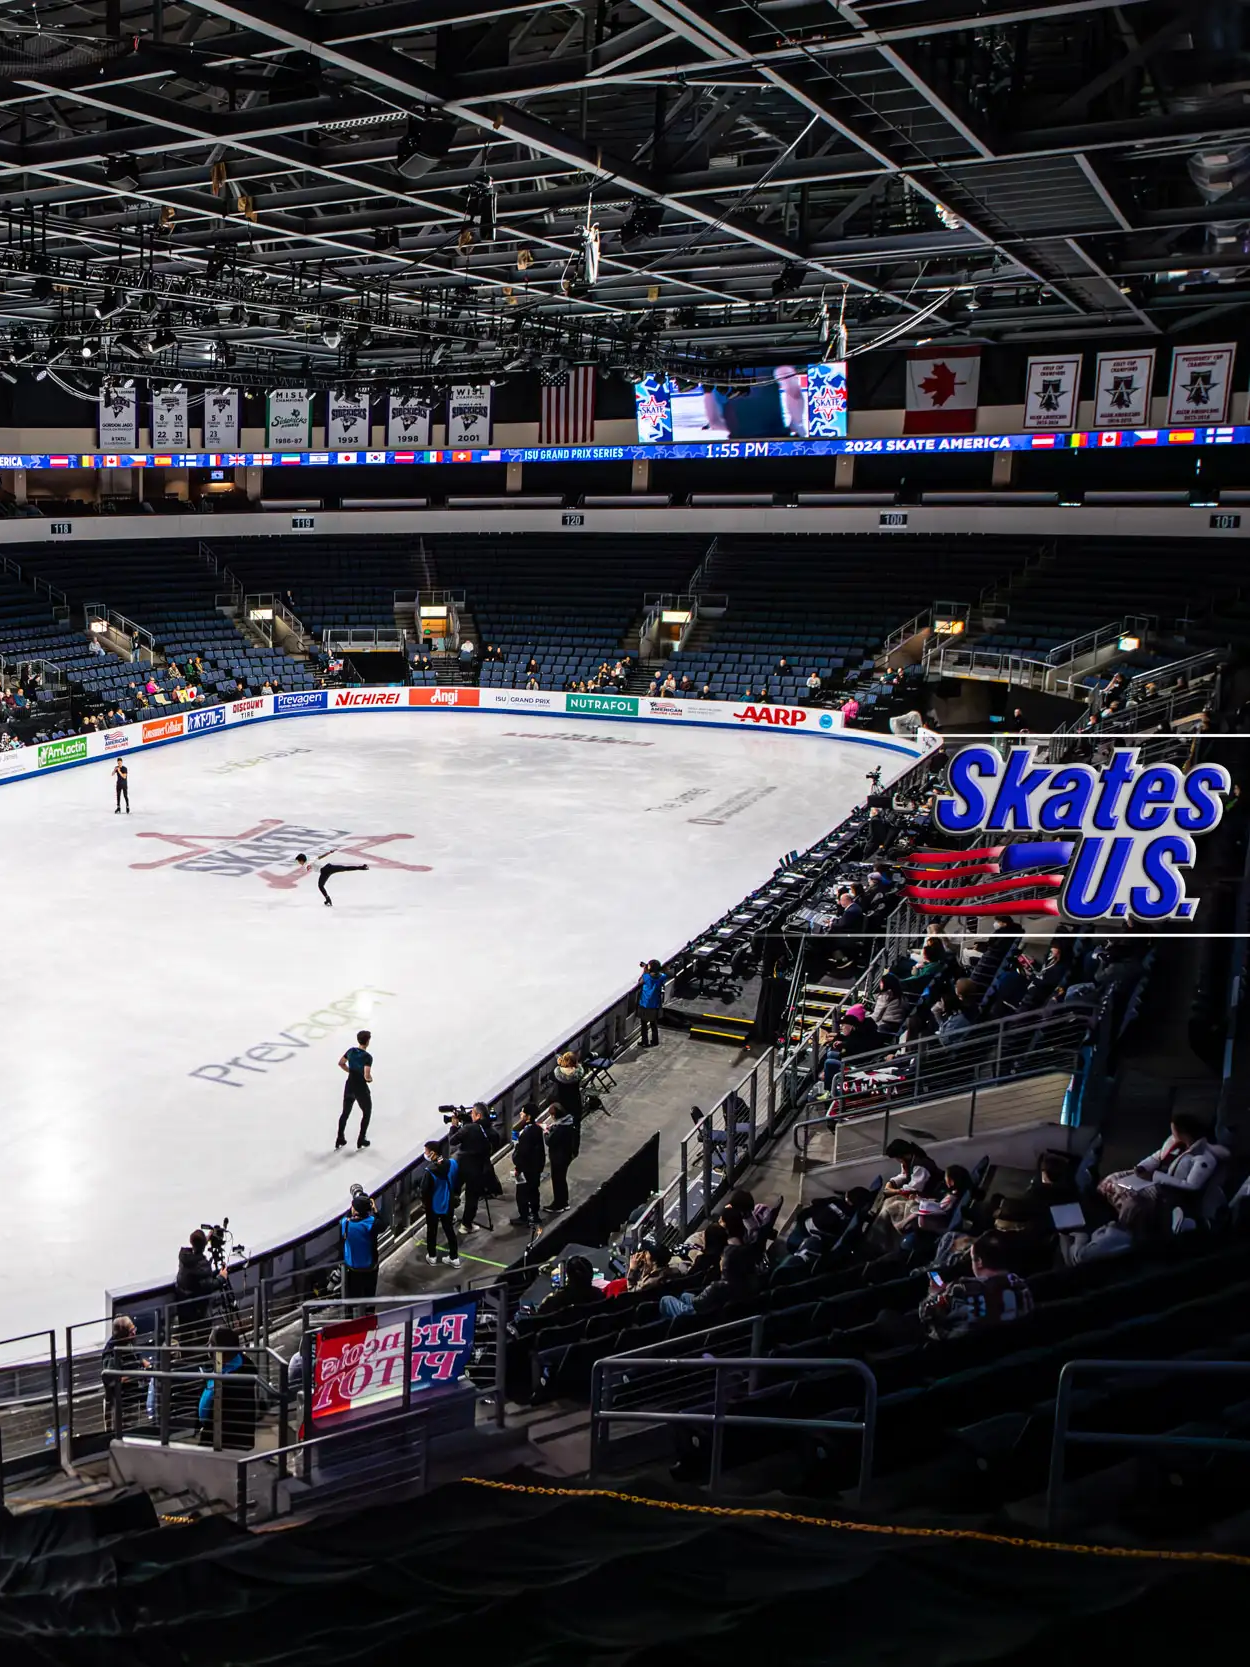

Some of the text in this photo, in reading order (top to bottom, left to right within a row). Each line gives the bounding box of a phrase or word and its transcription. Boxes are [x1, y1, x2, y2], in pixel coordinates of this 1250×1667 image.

[210, 430, 218, 438] 23
[338, 436, 359, 444] 1993
[707, 442, 769, 458] 1:55 PM
[845, 437, 1011, 452] 2024 SKATE AMERICA
[525, 448, 624, 460] ISU GRAND PRIX SERIES
[296, 519, 310, 528] 119
[566, 516, 580, 525] 120
[884, 514, 903, 526] 100
[1214, 515, 1235, 528] 101
[54, 524, 69, 534] 118
[278, 692, 322, 705] Prevagen
[335, 691, 400, 706] NICHIREI
[431, 689, 458, 705] Angi
[232, 699, 264, 713] DISCOUNT
[570, 698, 634, 712] NUTRAFOL
[241, 711, 254, 719] TIRE
[734, 706, 806, 727] AARP
[105, 736, 128, 746] AMERICAN
[48, 741, 86, 758] AmLactin
